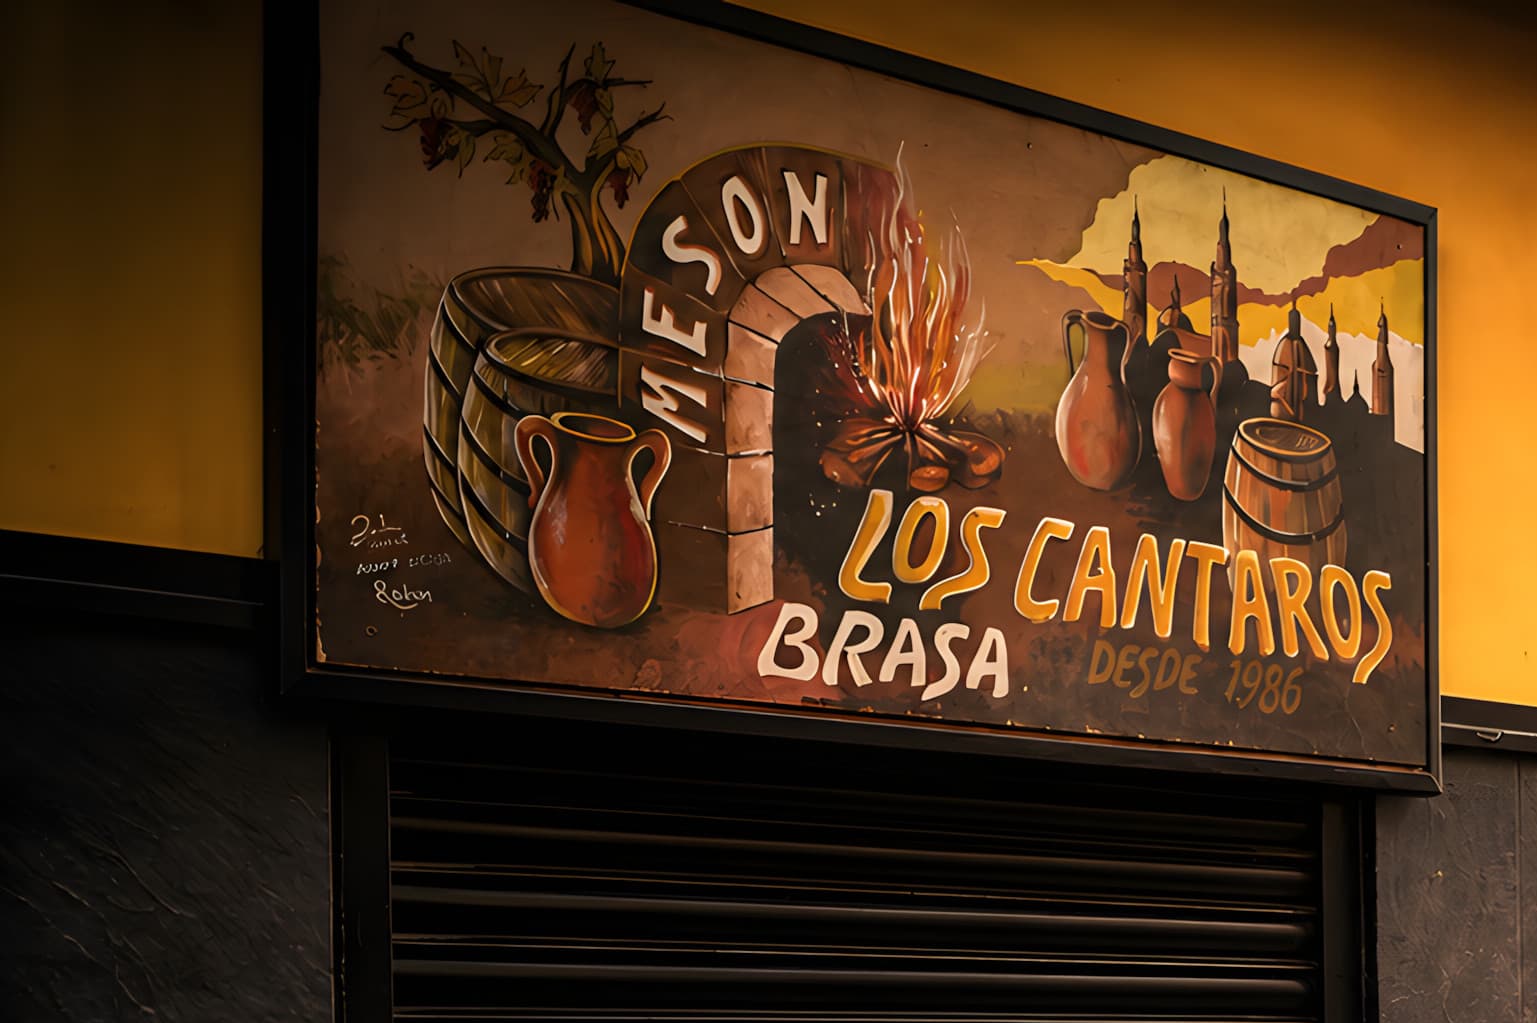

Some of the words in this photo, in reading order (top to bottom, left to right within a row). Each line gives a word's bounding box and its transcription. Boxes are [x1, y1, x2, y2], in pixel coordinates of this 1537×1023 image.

[641, 170, 828, 444] MESON
[757, 602, 1010, 701] BRASA
[838, 488, 1006, 611] LOS
[1014, 516, 1393, 685] CANTAROS
[1087, 639, 1202, 698] DESDE
[1224, 659, 1304, 714] 1986
